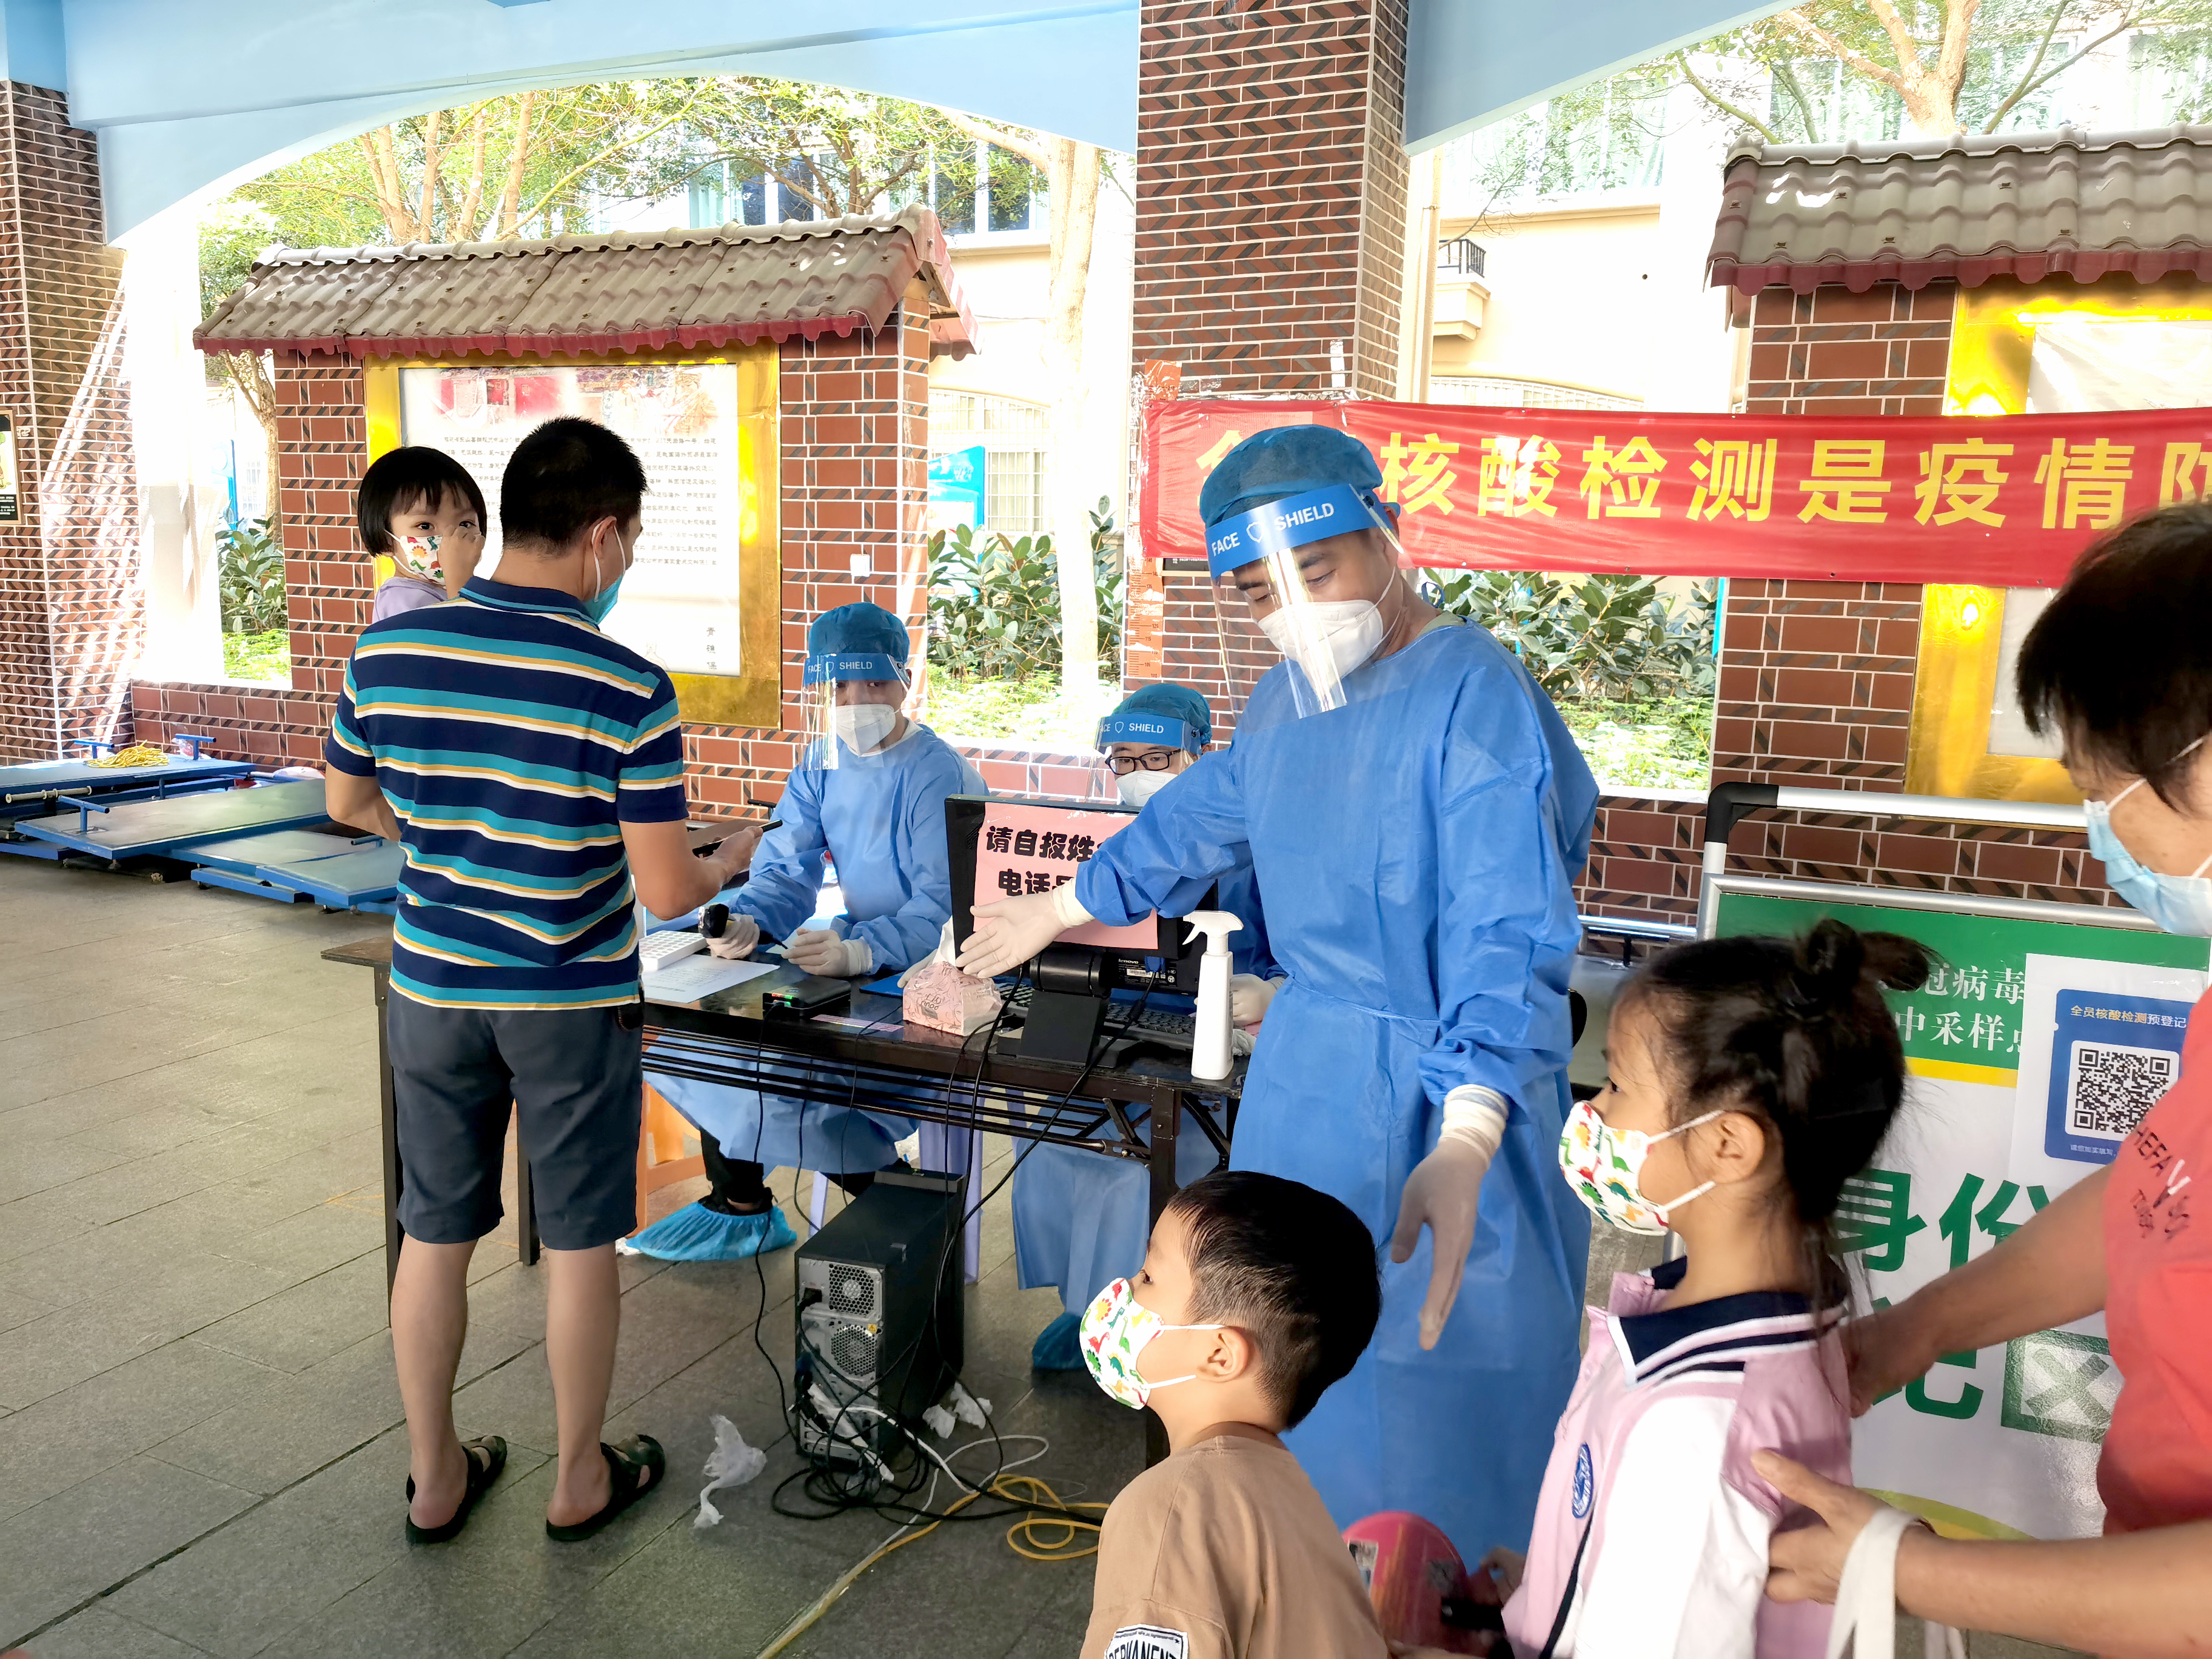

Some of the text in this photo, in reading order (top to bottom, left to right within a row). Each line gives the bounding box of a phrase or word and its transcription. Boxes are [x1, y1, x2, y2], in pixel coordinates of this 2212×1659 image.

[1196, 430, 2212, 529] 核酸检测是疫情
[1212, 503, 1334, 557] FACE SHIELD
[808, 661, 873, 674] FACE SHIELD
[1128, 722, 1164, 734] SHIELD
[986, 825, 1104, 862] 请自报姓
[2070, 1005, 2187, 1028] 全员核酸检测预登记
